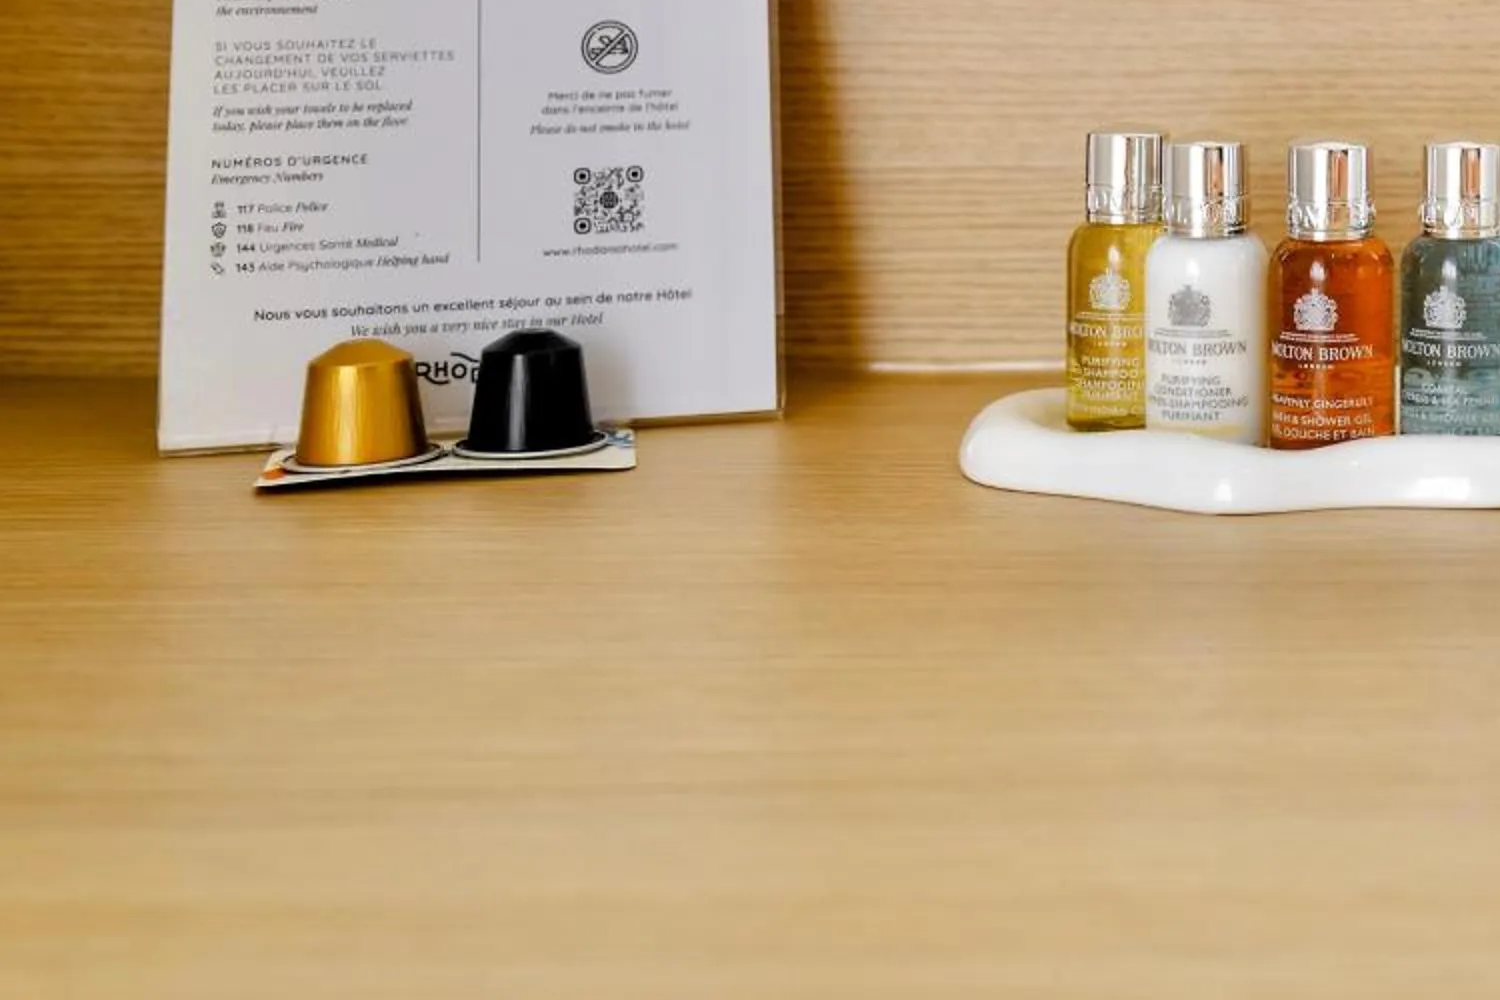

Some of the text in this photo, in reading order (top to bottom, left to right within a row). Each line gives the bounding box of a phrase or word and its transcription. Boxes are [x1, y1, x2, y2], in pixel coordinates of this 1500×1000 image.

[215, 38, 377, 51] SI VOUS SOUHAITEZ LE
[214, 54, 310, 65] CHANGEMENT
[317, 53, 334, 63] DE
[340, 51, 369, 63] VOS
[321, 66, 386, 77] VEUILLEZ
[213, 83, 238, 95] LES
[243, 82, 297, 93] PLACER
[303, 81, 329, 92] SUR
[335, 80, 351, 91] LE
[211, 154, 368, 169] NUMÉROS D'URGENCE
[237, 204, 254, 214] 117
[257, 203, 292, 214] Police
[237, 243, 255, 253] 144
[259, 241, 315, 254] Urgences
[258, 260, 285, 272] Aide
[254, 287, 692, 321] Nous vous souhaitons un excellent séjour au sein de notre Hôtel
[1192, 341, 1247, 356] BROWN
[1319, 344, 1373, 361] BROWN
